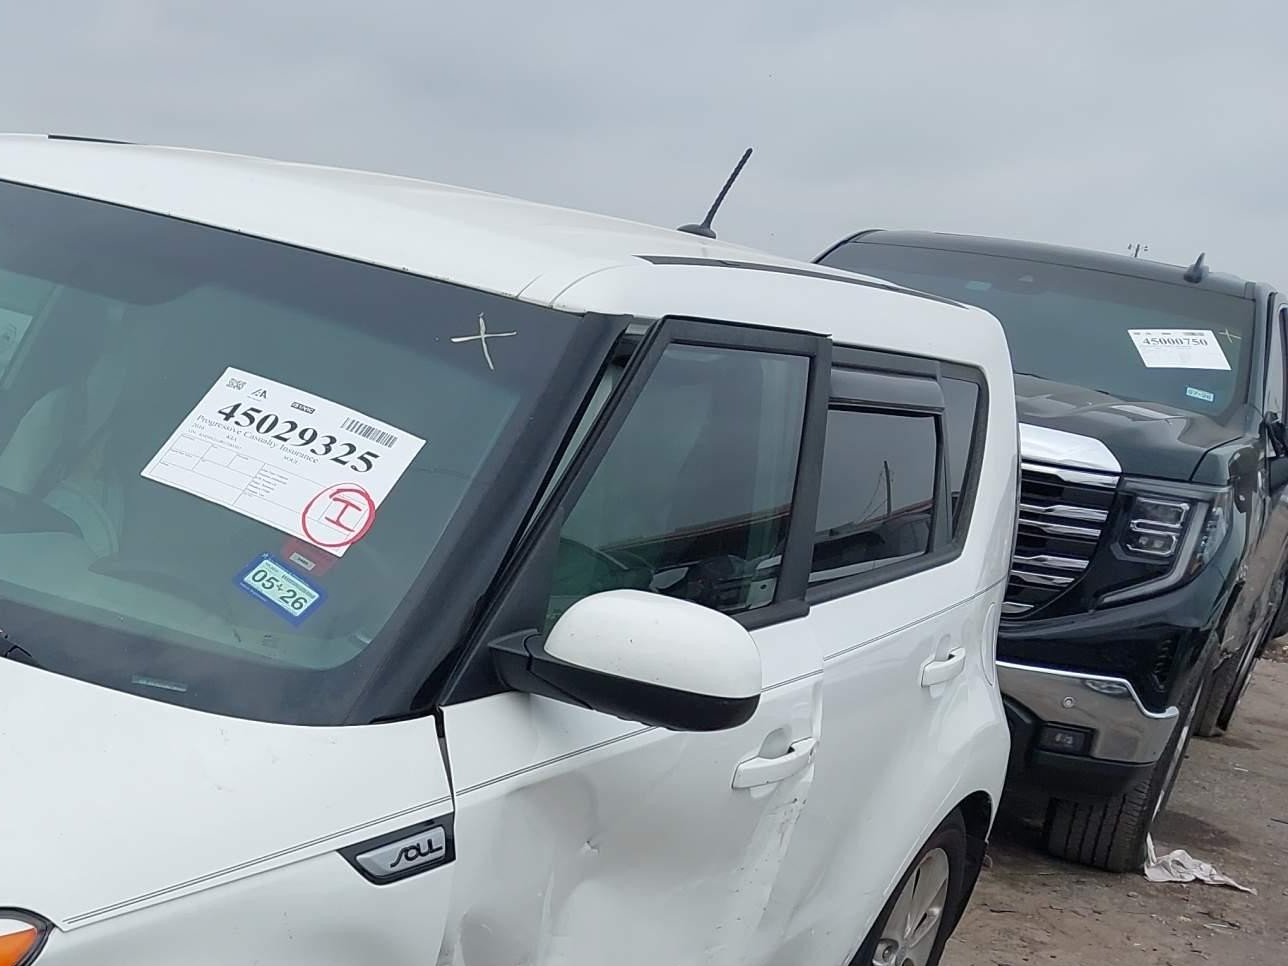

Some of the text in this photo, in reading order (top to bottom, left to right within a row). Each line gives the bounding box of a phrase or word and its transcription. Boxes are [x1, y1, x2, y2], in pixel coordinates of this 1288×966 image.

[1143, 337, 1208, 346] 45000750
[196, 414, 243, 435] Progressive
[243, 427, 278, 449] Casualty
[279, 443, 319, 464] Insurance
[218, 402, 380, 473] 45029325
